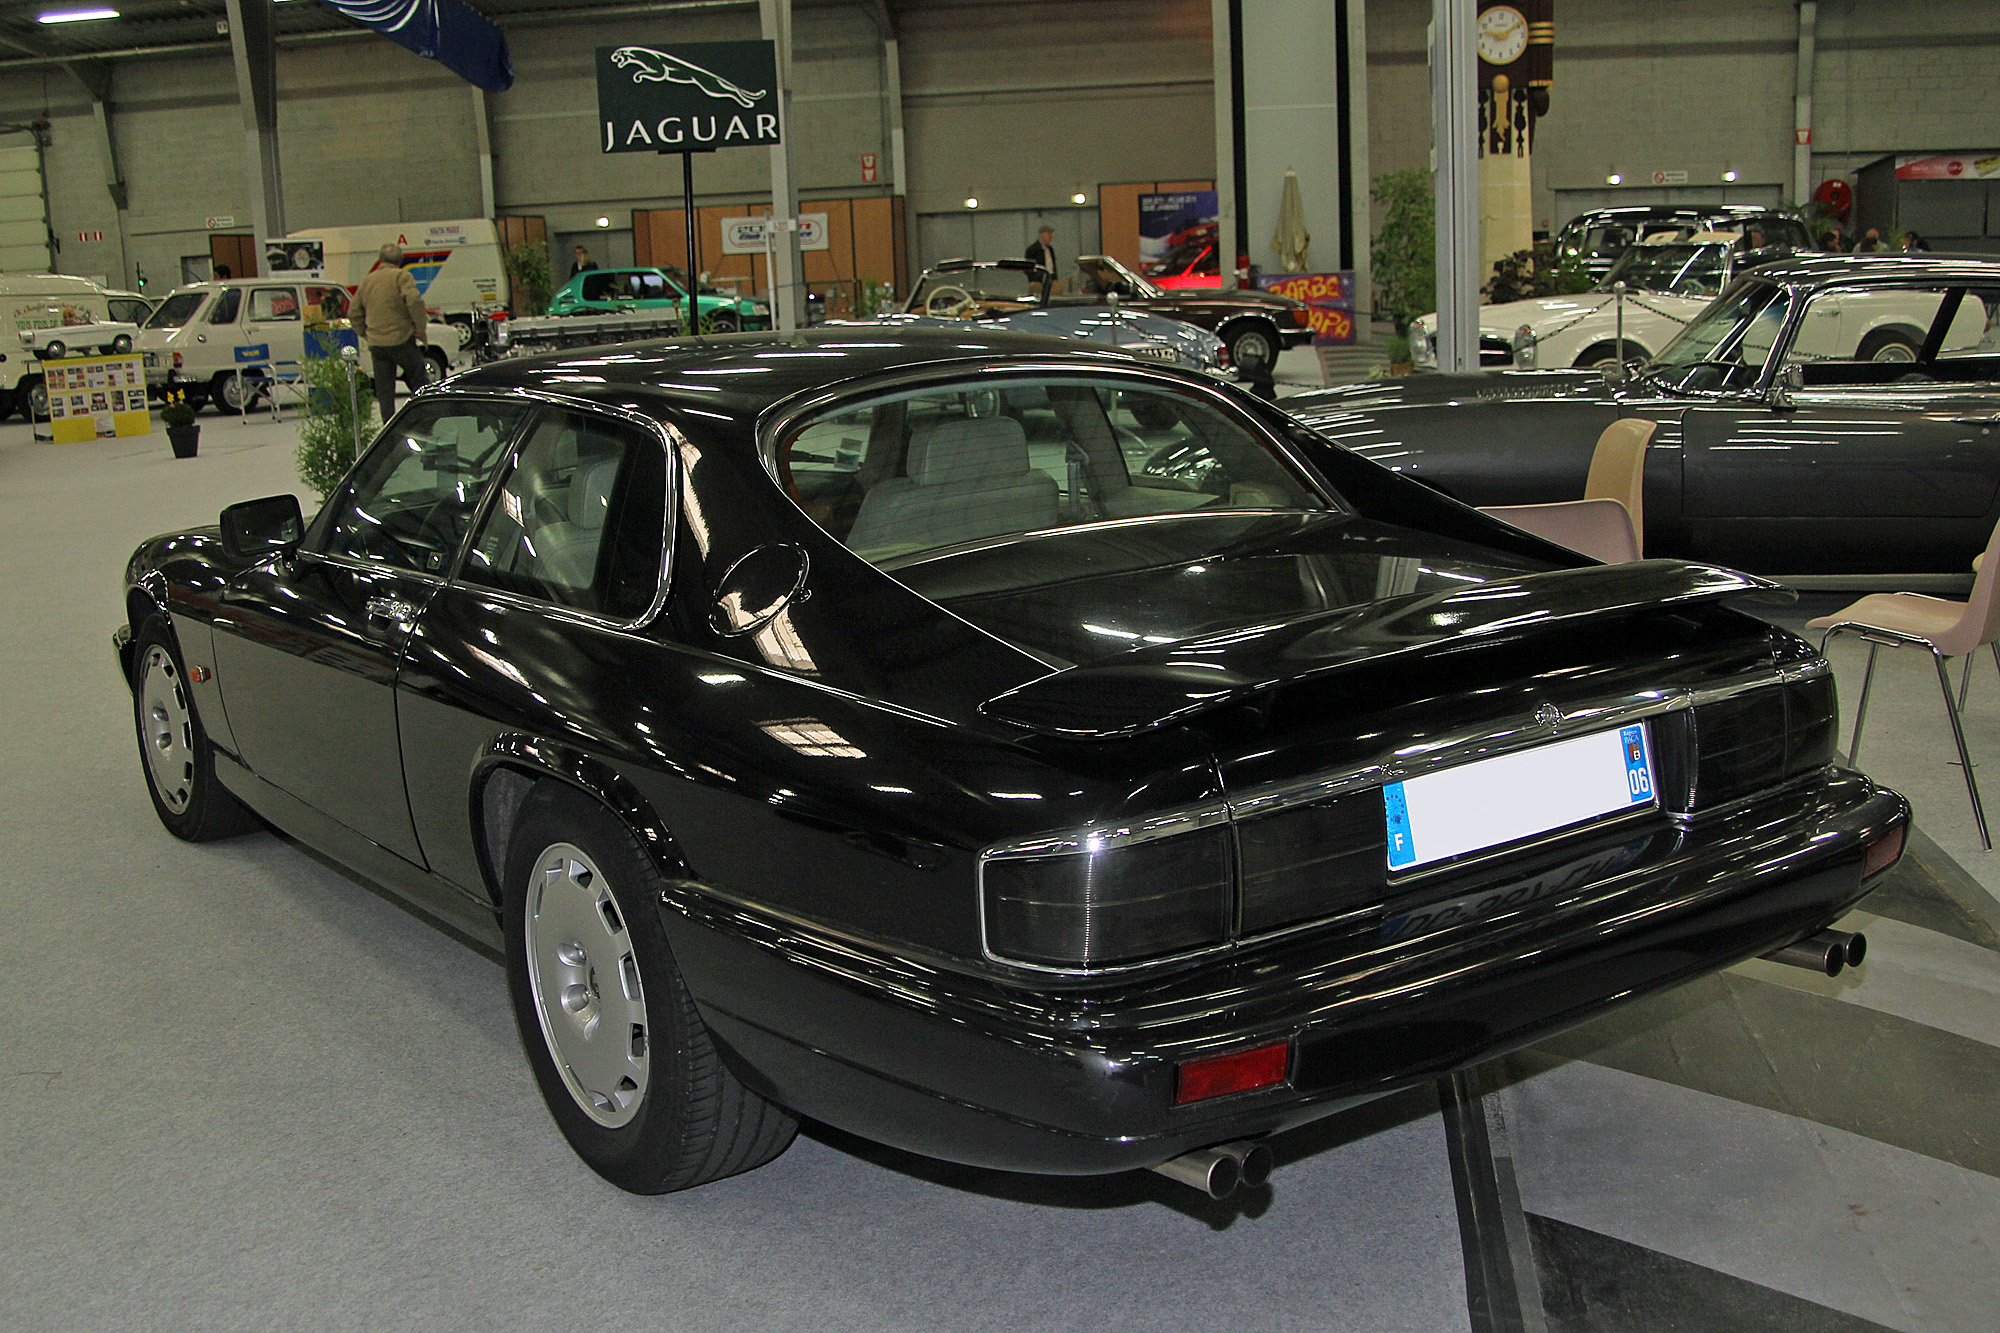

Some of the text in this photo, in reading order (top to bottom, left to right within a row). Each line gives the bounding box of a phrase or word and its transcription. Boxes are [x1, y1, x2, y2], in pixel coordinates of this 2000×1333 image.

[605, 113, 778, 152] JAGUAR
[398, 233, 408, 246] A
[1308, 310, 1351, 338] APA
[1624, 734, 1640, 744] PACA
[1628, 767, 1650, 795] 06
[1394, 832, 1404, 852] F
